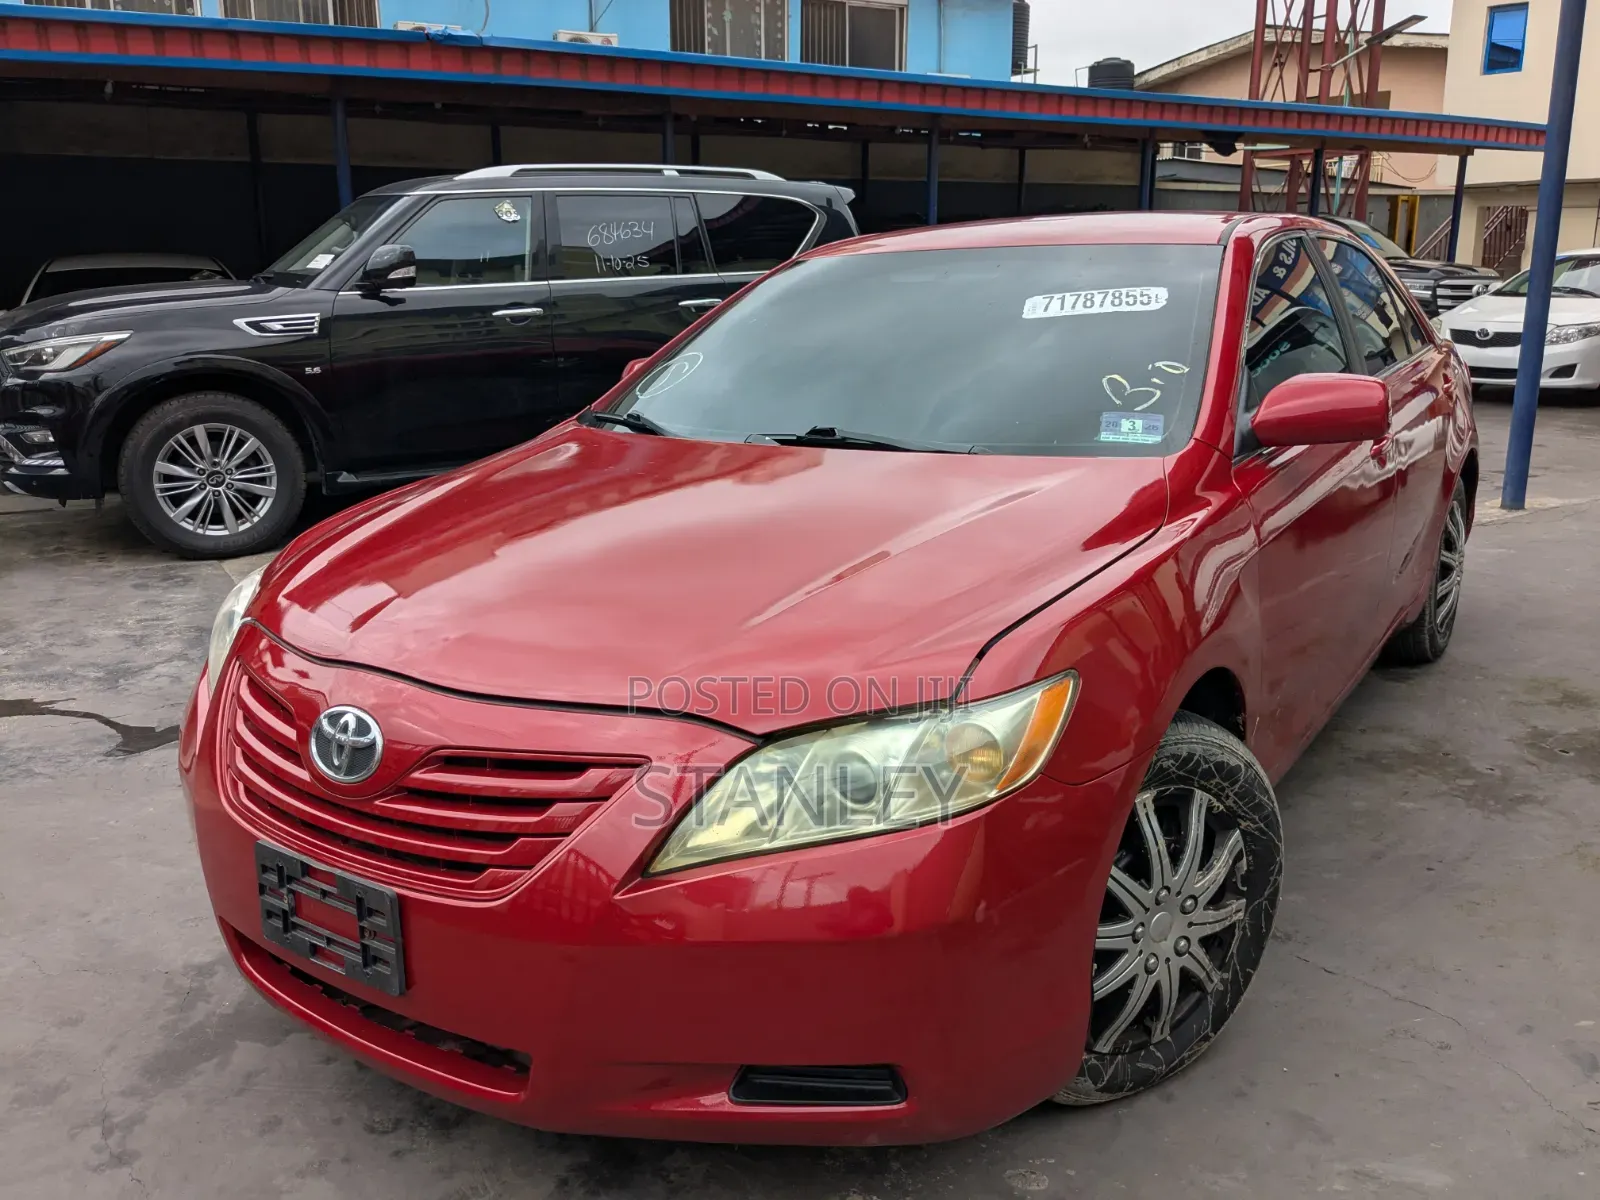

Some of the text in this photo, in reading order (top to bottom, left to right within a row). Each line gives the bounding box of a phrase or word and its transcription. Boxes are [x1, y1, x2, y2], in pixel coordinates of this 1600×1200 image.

[587, 221, 654, 246] 684634
[1042, 290, 1152, 312] 71787855
[1128, 420, 1136, 431] 3
